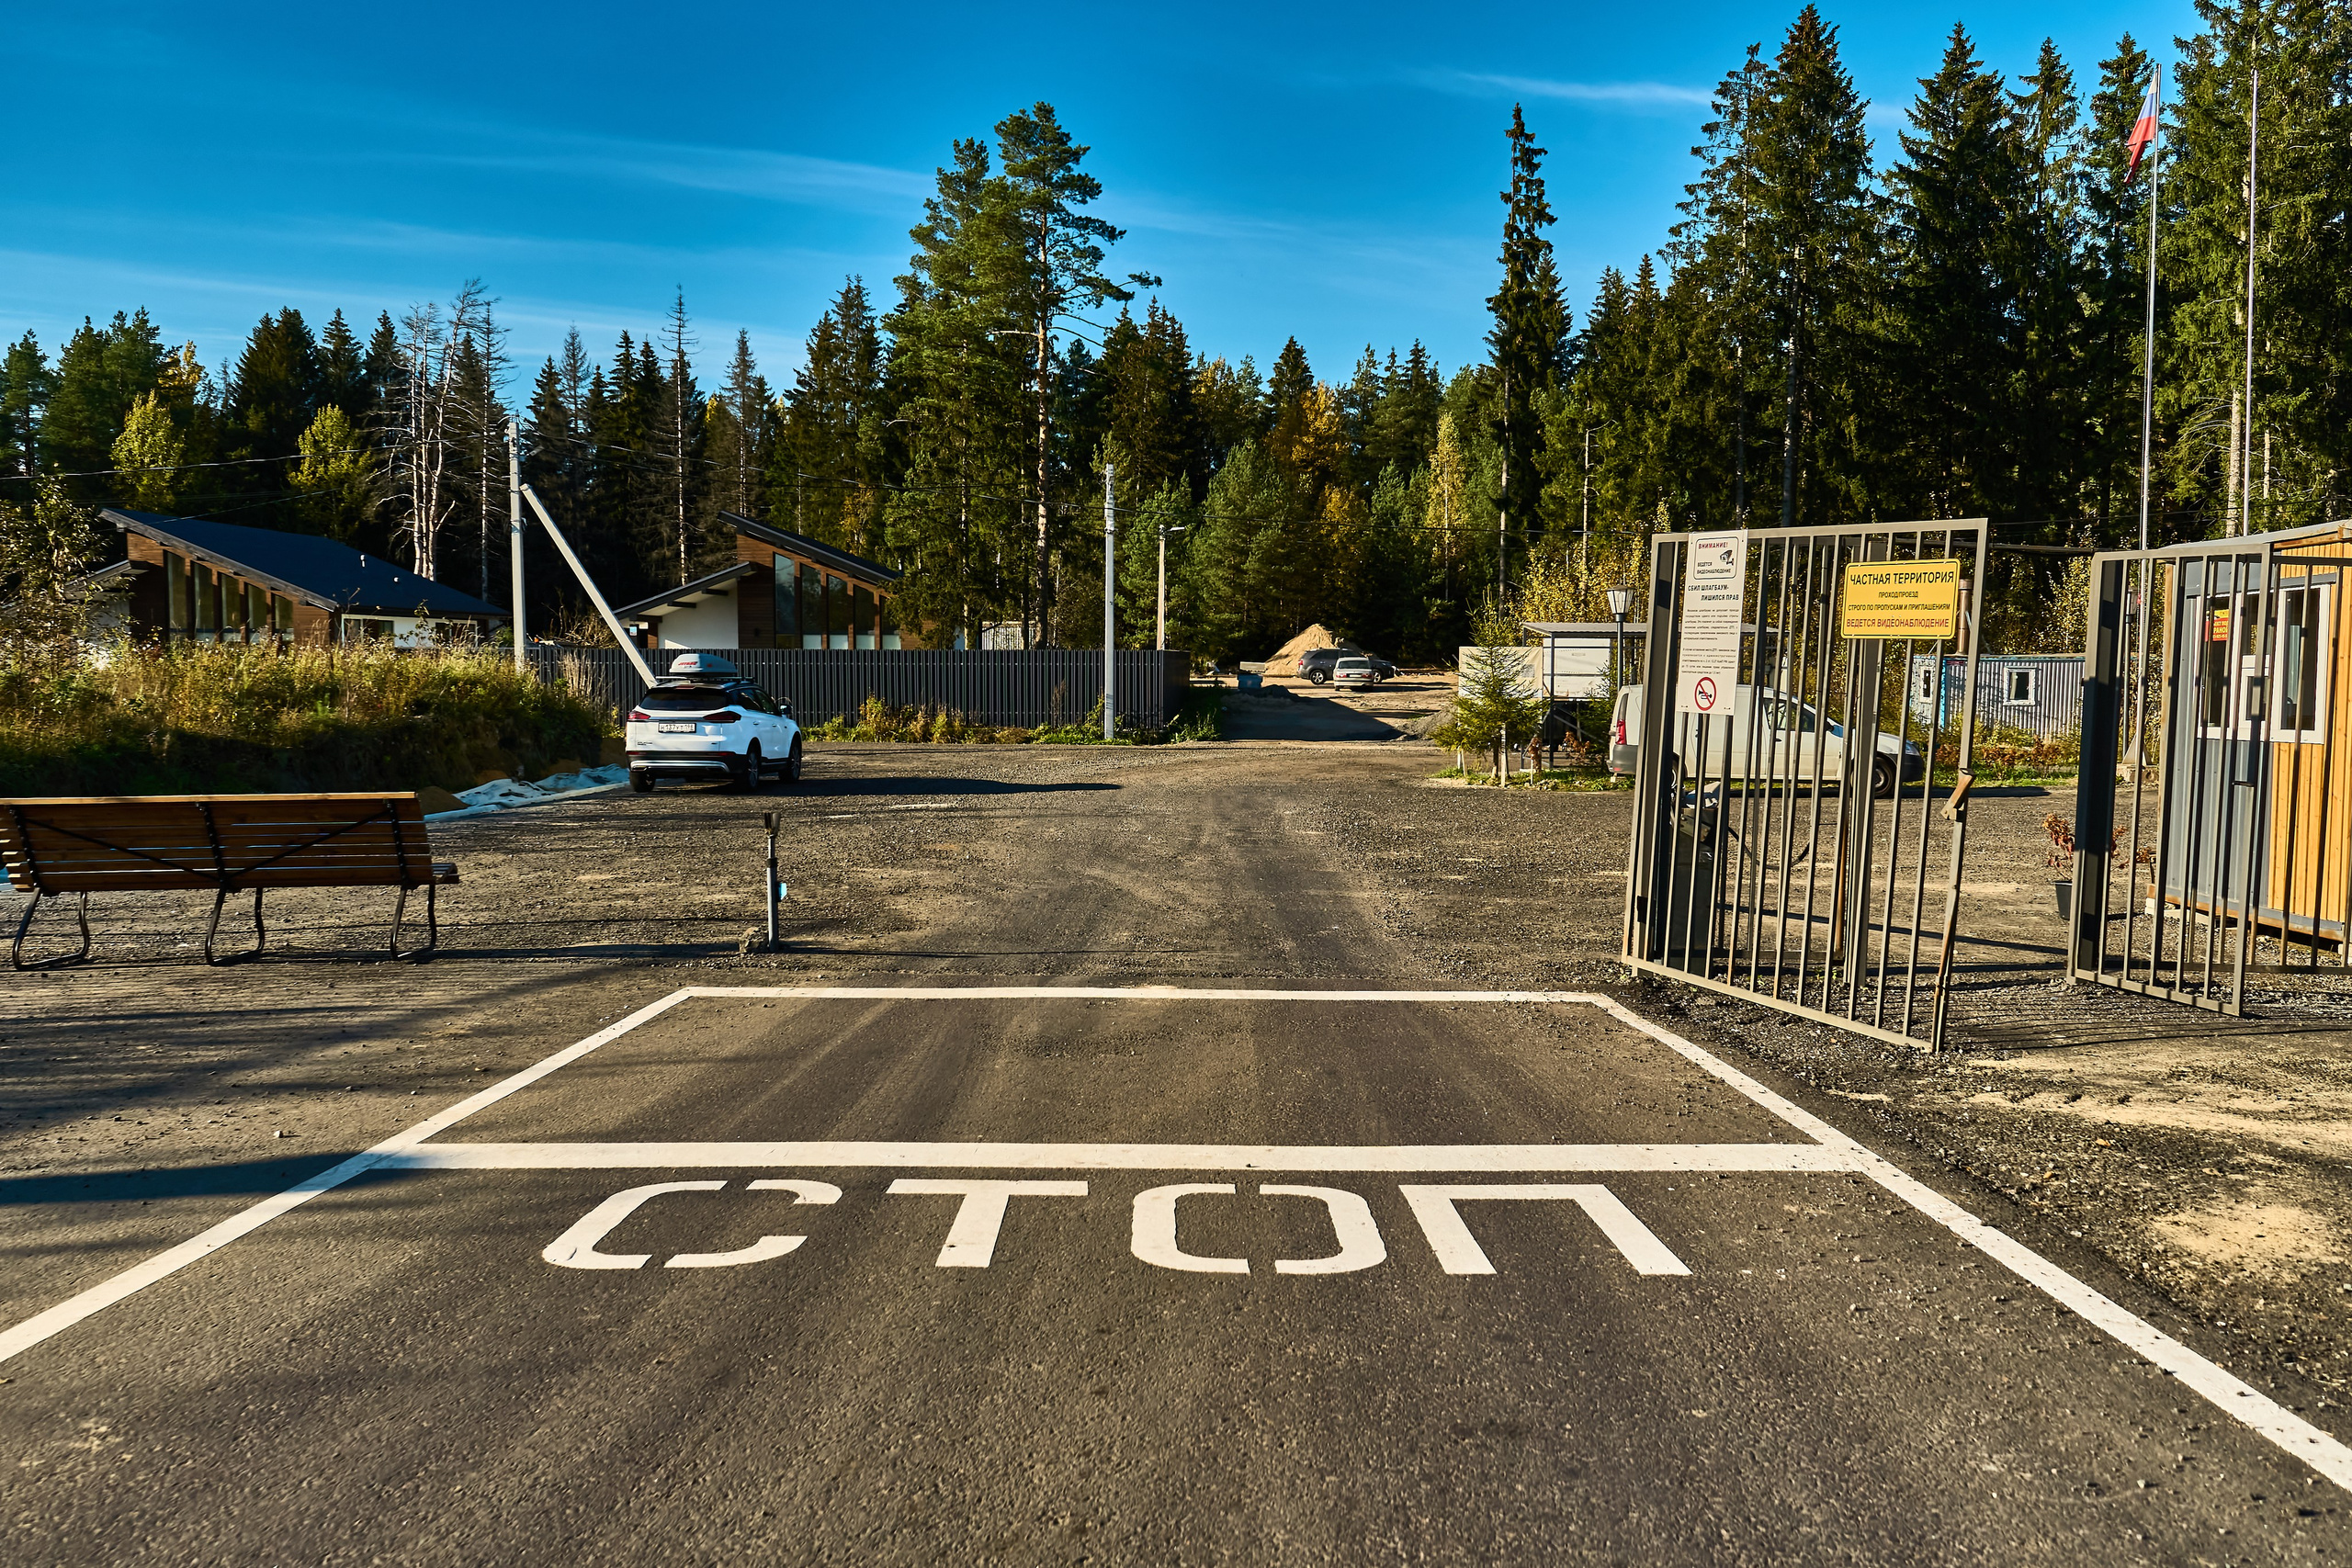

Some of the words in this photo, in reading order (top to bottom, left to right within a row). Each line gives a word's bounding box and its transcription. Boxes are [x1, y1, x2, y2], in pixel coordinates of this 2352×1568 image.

[1850, 573, 1891, 585] ЧАСТНАЯ
[1894, 571, 1954, 584] ТЕРРИТОРИЯ
[1847, 619, 1876, 628] ВЕДЕТСЯ
[1877, 618, 1950, 628] ВИДЕОНАБЛЮДЕНИЕ
[541, 1178, 1693, 1277] СТОП
